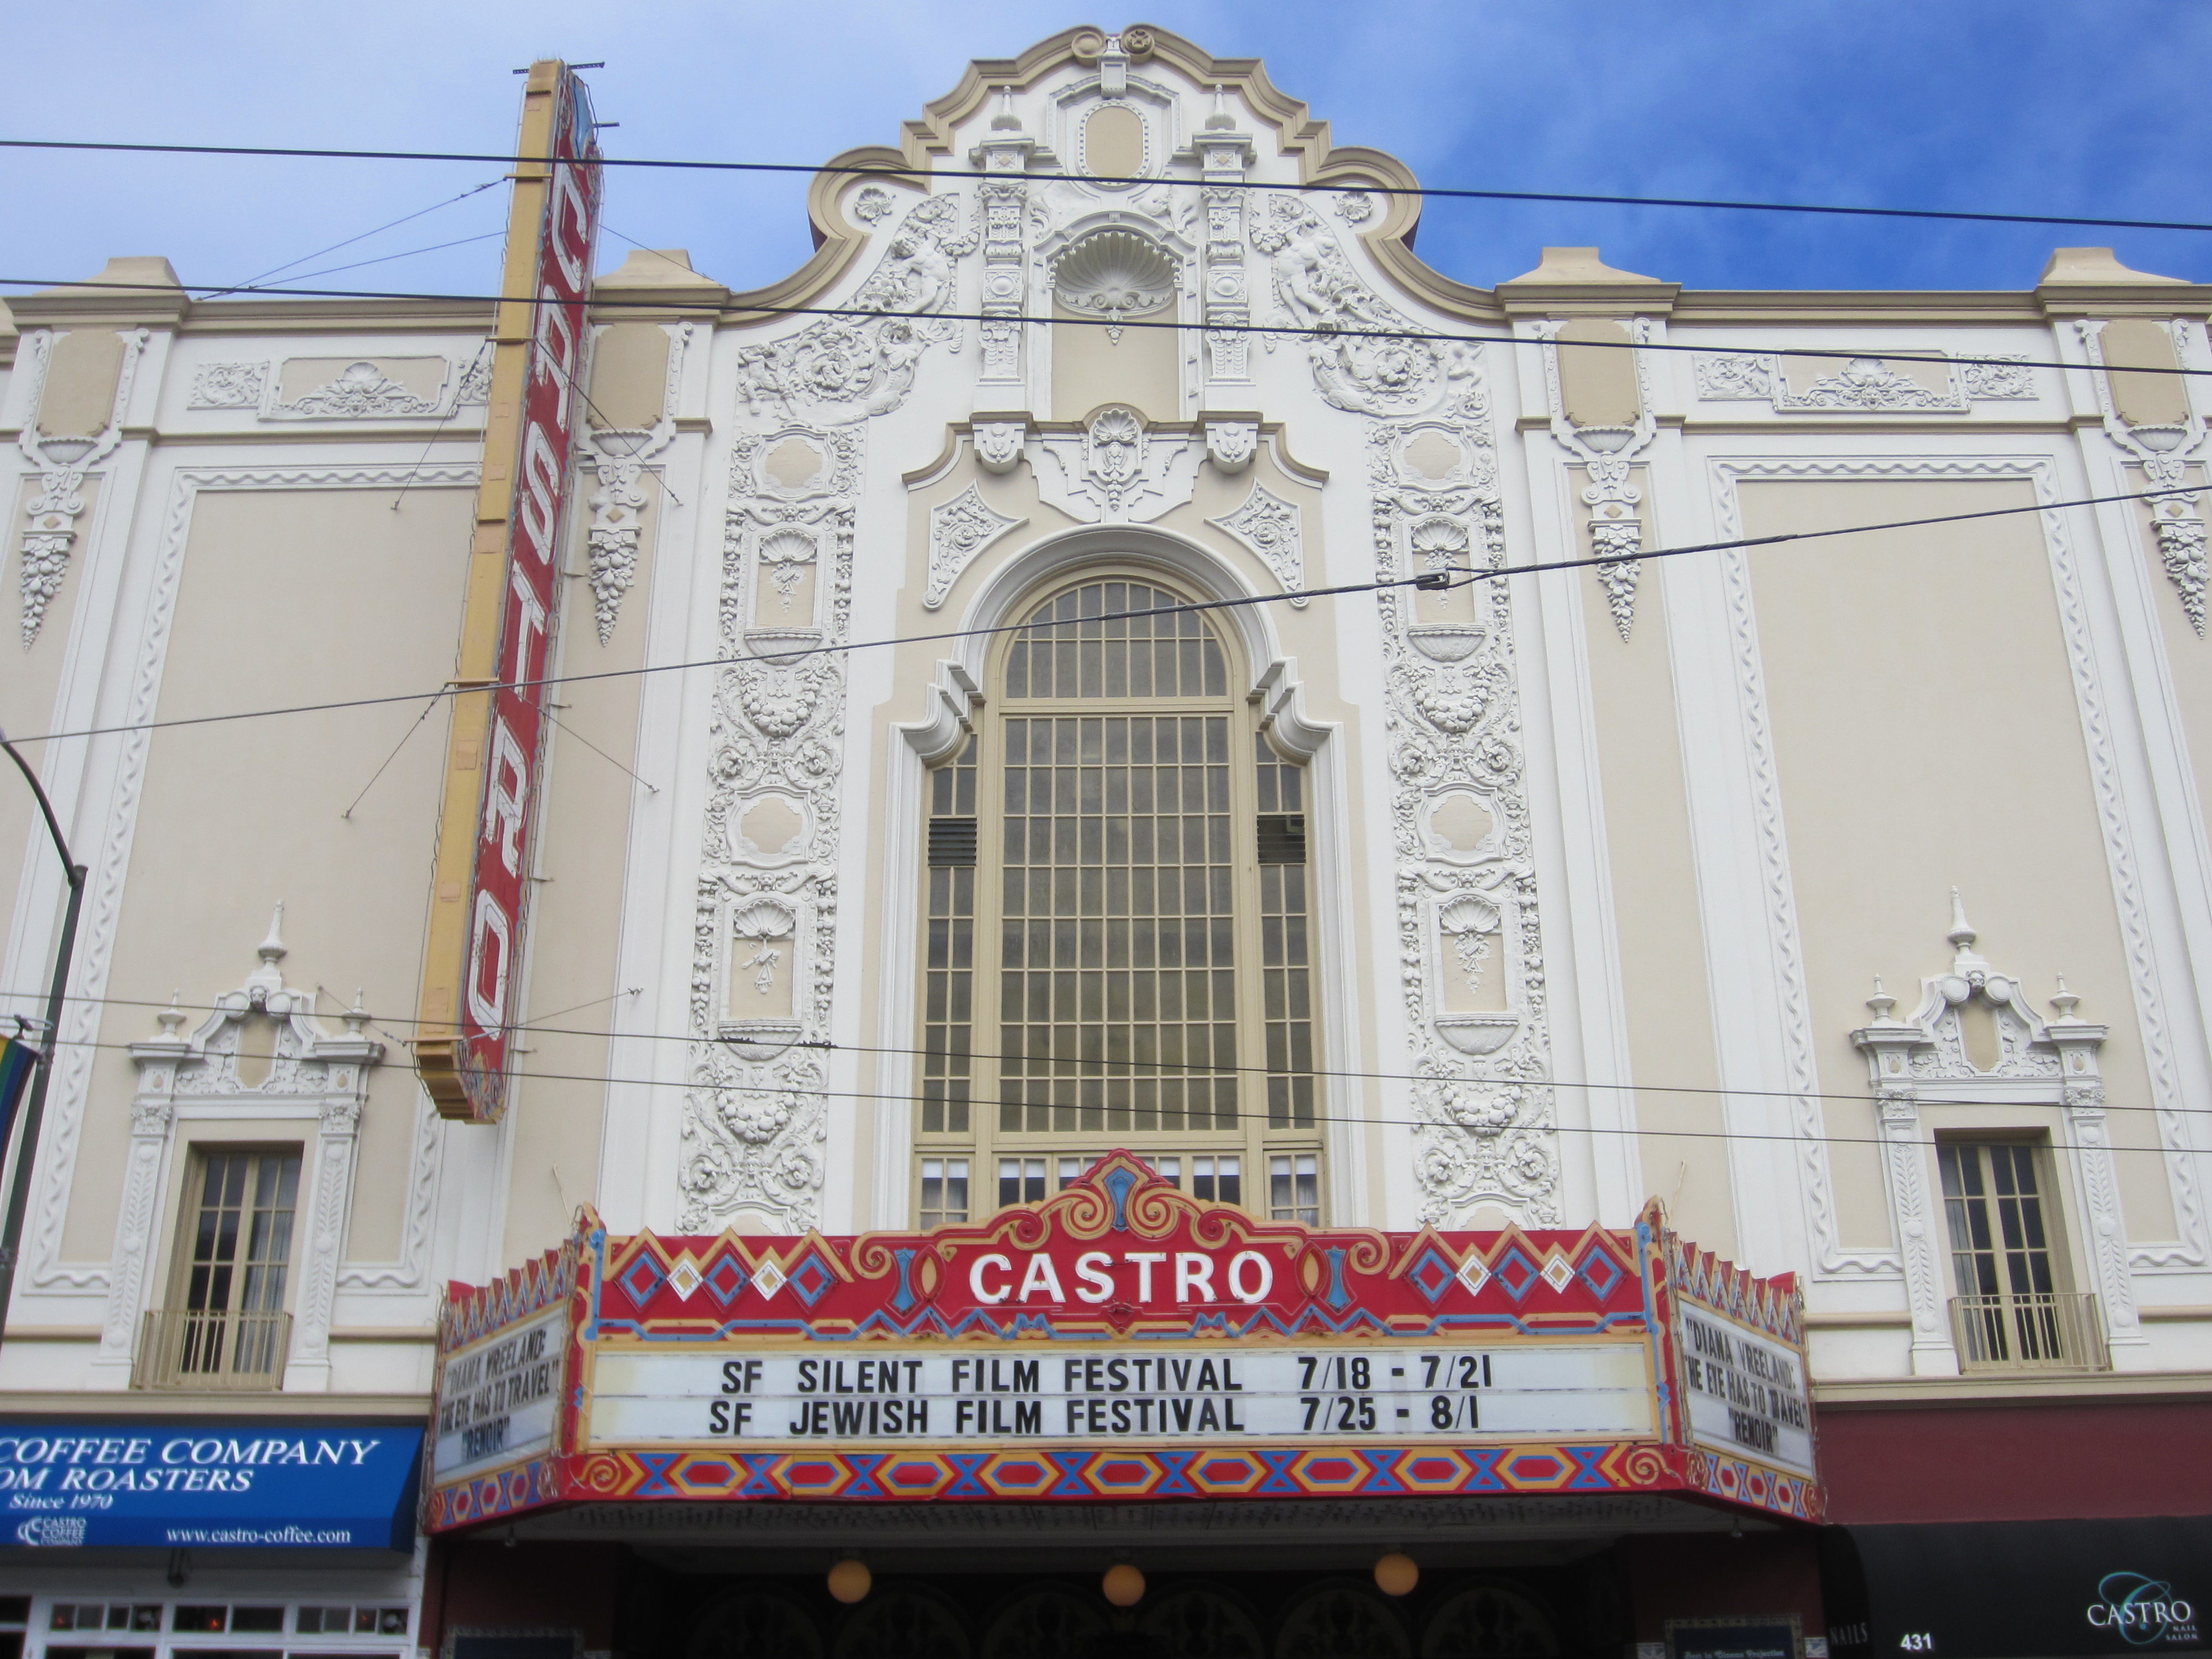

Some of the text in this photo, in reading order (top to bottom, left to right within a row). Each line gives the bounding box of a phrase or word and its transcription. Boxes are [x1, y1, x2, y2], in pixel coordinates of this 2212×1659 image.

[467, 156, 587, 1041] CASTRO
[969, 1251, 1273, 1305] CASTRO
[486, 1329, 546, 1380] VREELAND:
[1686, 1317, 1796, 1390] "DIANA VREELAND:
[722, 1355, 1492, 1394] SF SILENT FILM FESTIVAL 7/18 - 7/21
[1686, 1355, 1703, 1391] HE
[1706, 1361, 1726, 1399] EYE
[1727, 1369, 1750, 1408] HAS
[1750, 1381, 1766, 1415] TO
[473, 1385, 491, 1422] HAS
[709, 1395, 1479, 1435] SF JEWISH FILM FESTIVAL 7/25 - 8/1
[1728, 1406, 1778, 1453] "RENOIR"
[0, 1437, 380, 1465] COFFEE COMPANY
[59, 1467, 254, 1492] ROASTERS
[9, 1493, 113, 1509] Since 1970
[41, 1527, 85, 1538] COFFEE
[43, 1517, 86, 1528] CASTRO
[167, 1525, 351, 1544] www.castro-coffee.com
[2087, 1600, 2192, 1626] CASTRO
[1829, 1621, 1868, 1645] NAILS
[1900, 1632, 1933, 1651] 431
